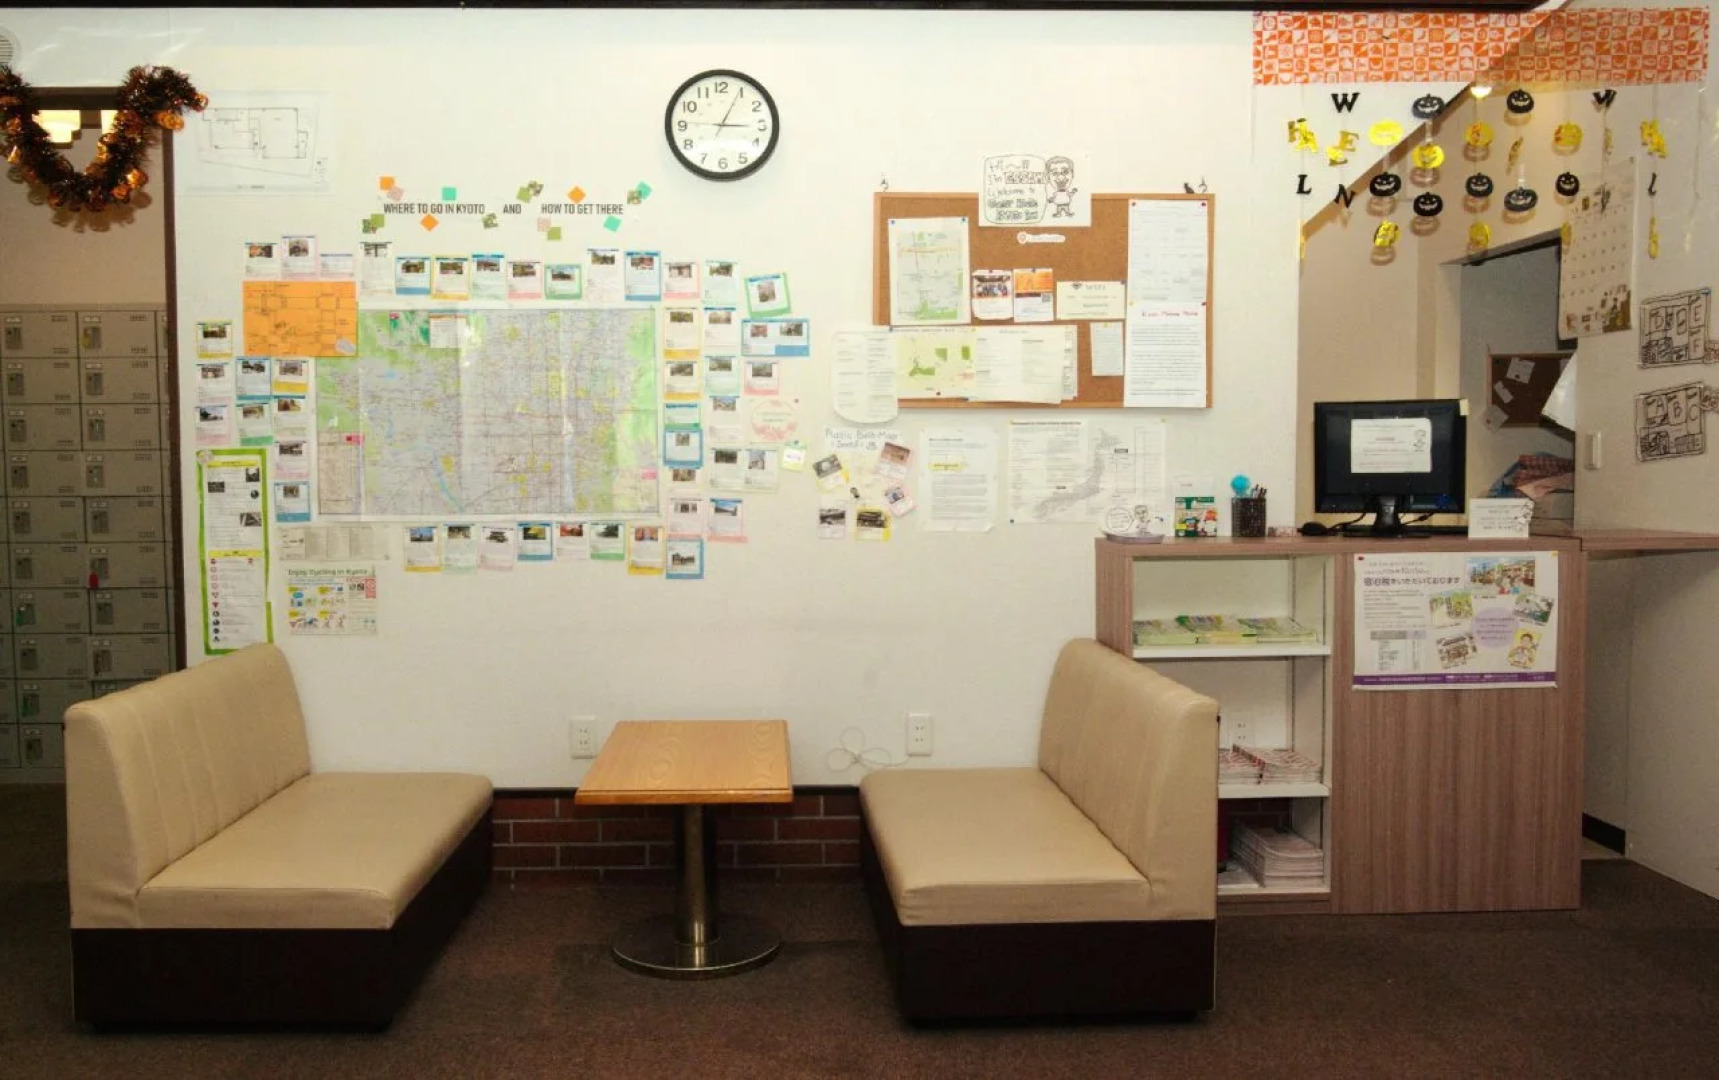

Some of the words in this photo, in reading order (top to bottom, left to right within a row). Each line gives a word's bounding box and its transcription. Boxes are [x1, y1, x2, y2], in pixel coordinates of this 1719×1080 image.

[697, 86, 709, 98] 11
[714, 81, 729, 94] 12
[682, 100, 697, 113] 10
[751, 100, 761, 112] 2
[1331, 92, 1360, 113] W
[677, 120, 688, 132] 9
[757, 119, 767, 131] 3
[683, 138, 693, 149] 8
[751, 137, 760, 147] 4
[1338, 130, 1359, 152] E
[700, 152, 708, 164] 7
[718, 157, 728, 169] 6
[738, 152, 748, 164] 5
[1296, 174, 1312, 195] L
[1334, 184, 1356, 208] N
[383, 203, 415, 215] WHERE
[417, 203, 428, 214] TO
[430, 203, 443, 214] GO
[445, 204, 454, 214] IN
[456, 203, 485, 214] KYOTO
[503, 203, 521, 214] AND
[541, 203, 561, 214] HOW
[564, 203, 575, 214] TO
[575, 203, 593, 214] GET
[596, 203, 623, 214] THERE
